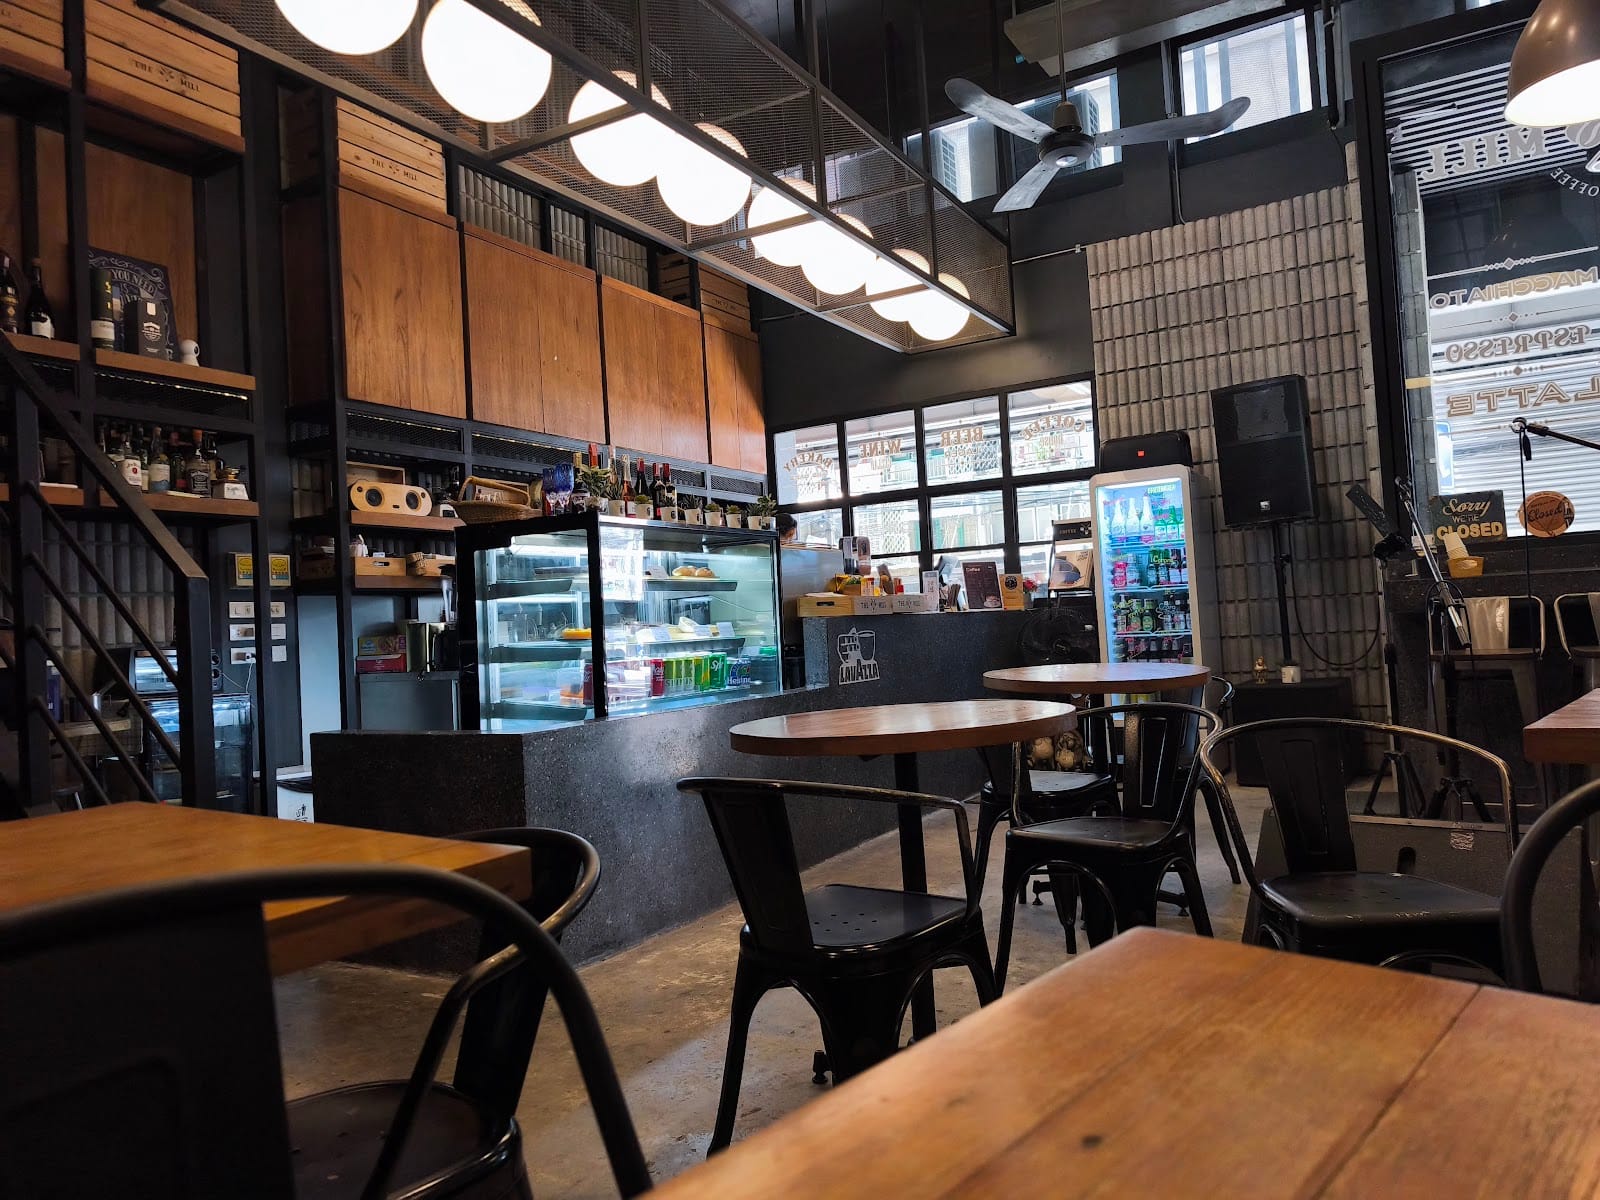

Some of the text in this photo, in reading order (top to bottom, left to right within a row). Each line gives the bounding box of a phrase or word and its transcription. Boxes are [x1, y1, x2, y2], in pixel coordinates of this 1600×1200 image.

[180, 78, 199, 91] MILL
[403, 170, 418, 181] MILL
[111, 268, 156, 294] YOU NEED
[1443, 499, 1491, 517] Sorry
[840, 658, 879, 683] LAVAZZA
